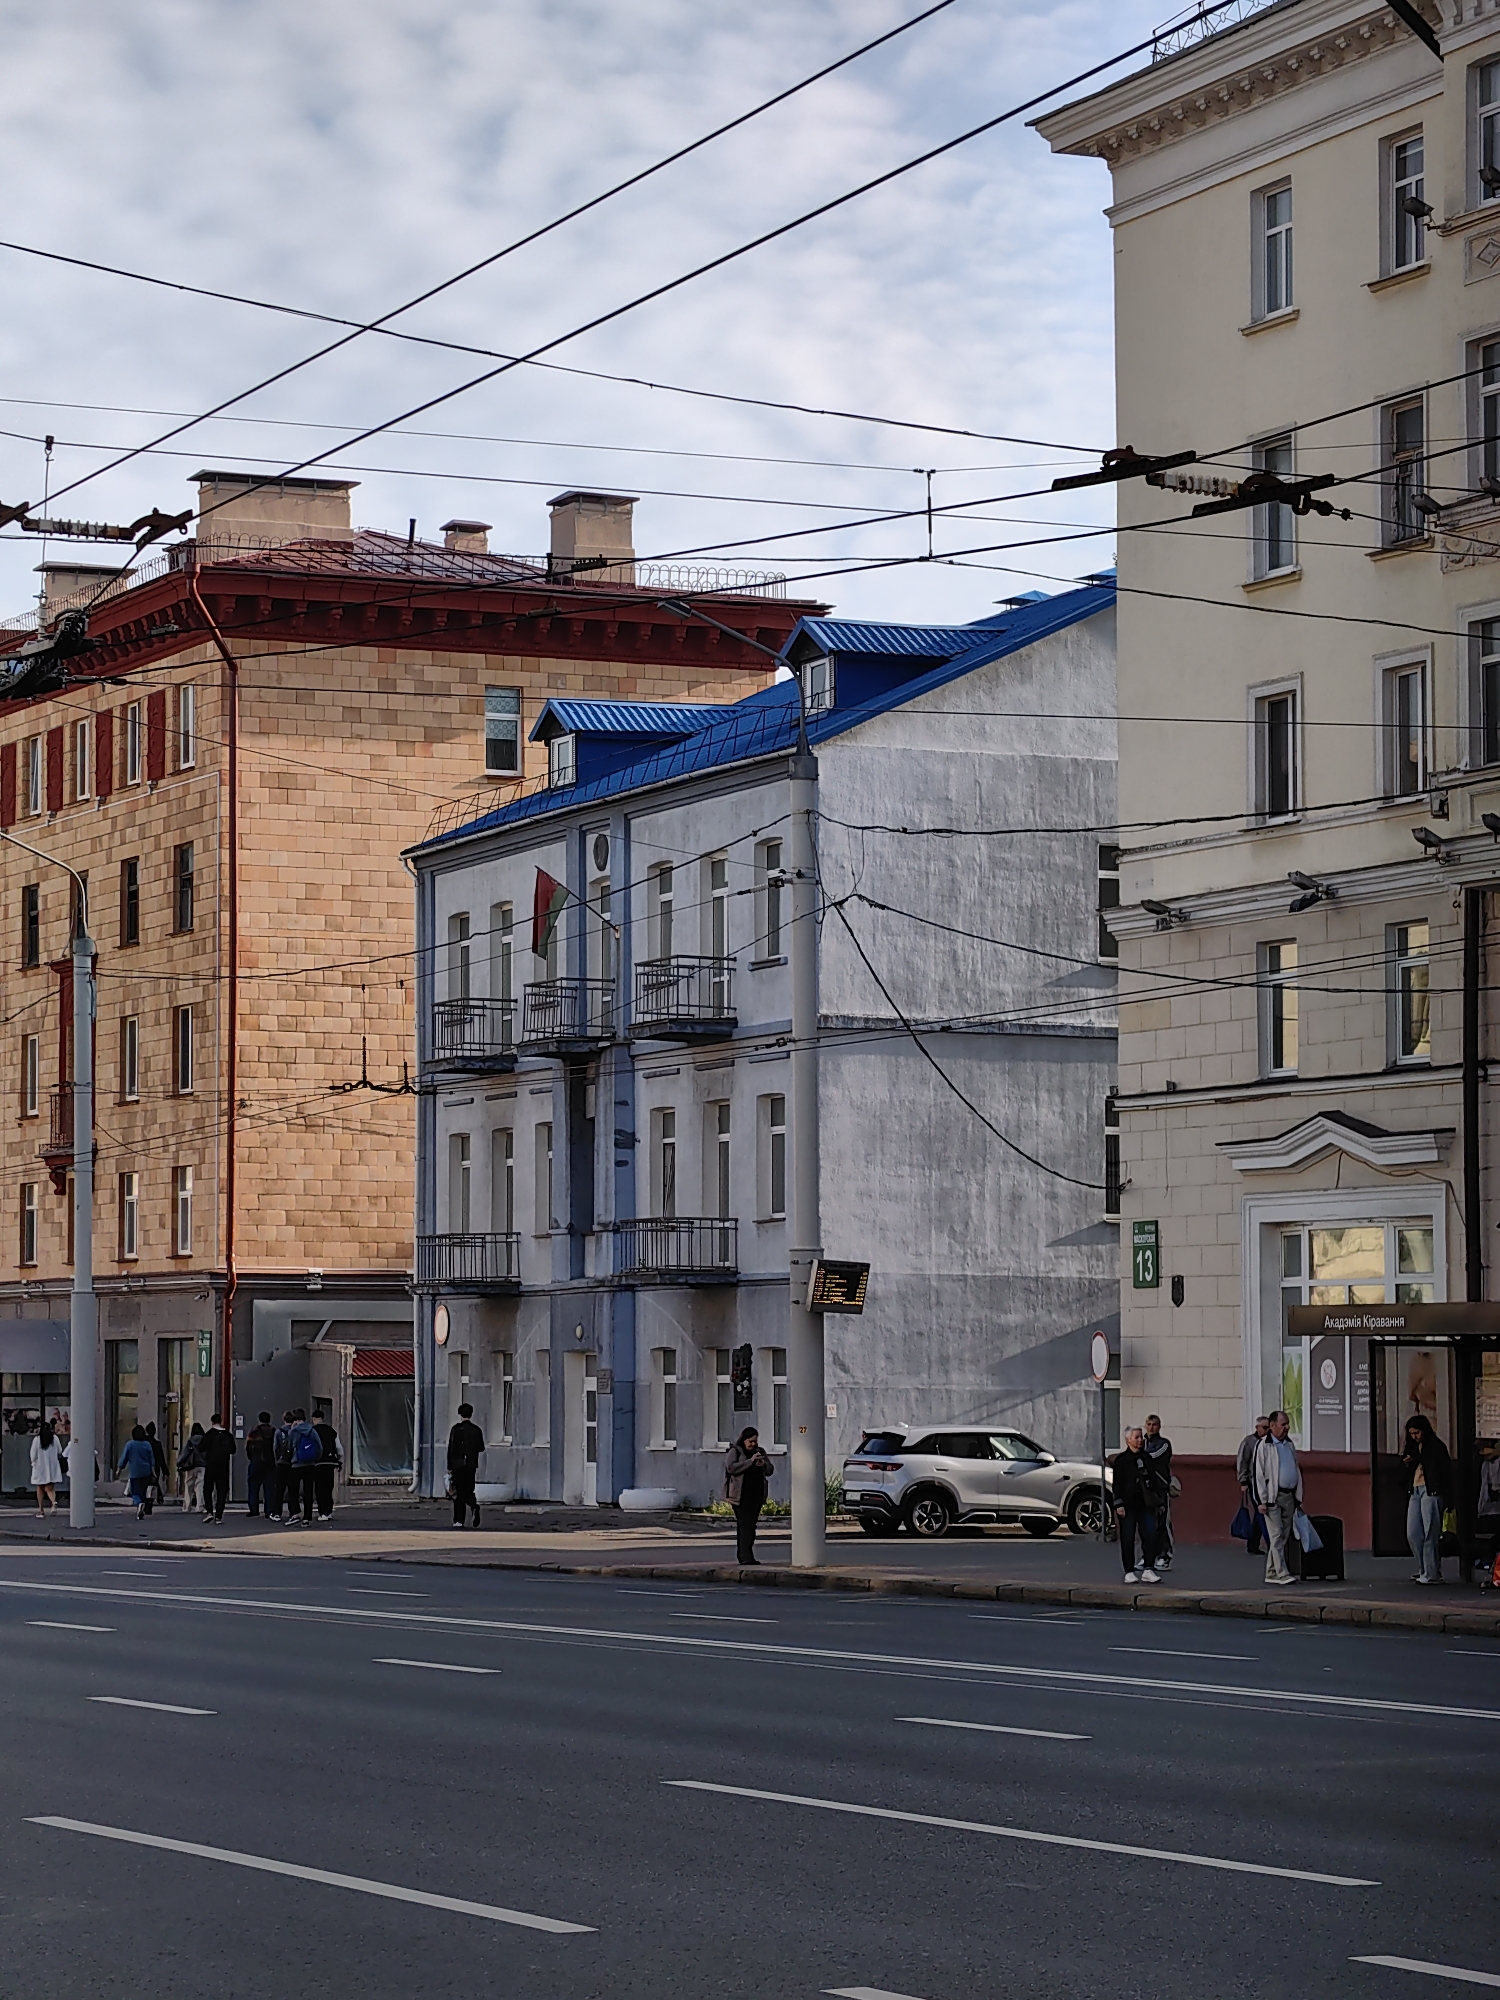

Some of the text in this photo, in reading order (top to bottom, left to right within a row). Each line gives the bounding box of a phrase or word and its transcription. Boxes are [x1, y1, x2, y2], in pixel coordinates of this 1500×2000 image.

[1136, 1249, 1153, 1282] 13
[1324, 1314, 1405, 1330] Акадэмія Кіравання
[201, 1350, 207, 1373] 9
